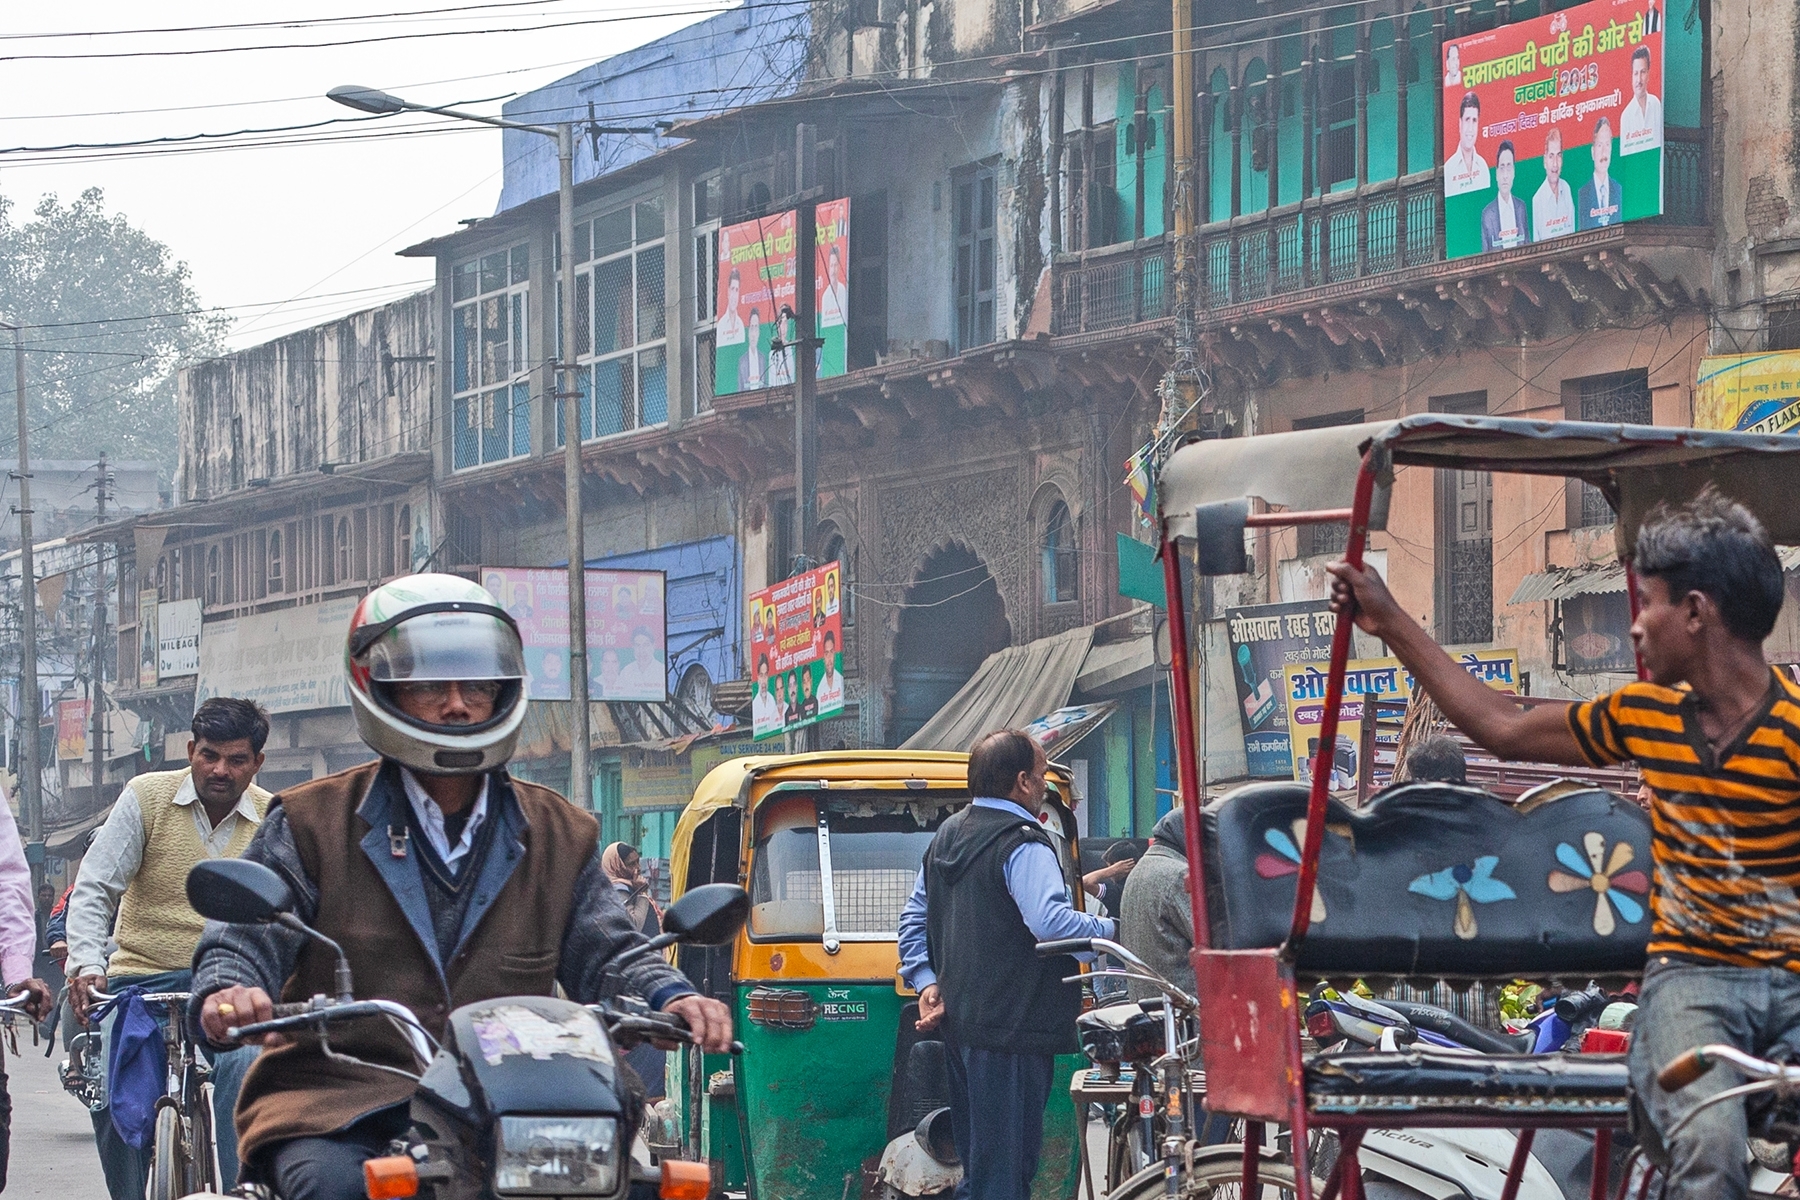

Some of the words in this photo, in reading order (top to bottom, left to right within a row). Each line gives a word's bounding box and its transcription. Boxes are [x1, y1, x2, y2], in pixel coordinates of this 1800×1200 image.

[1462, 41, 1537, 88] समाजवादी
[1540, 32, 1569, 67] पार्टी
[1573, 26, 1594, 59] की
[1597, 21, 1625, 53] ओर
[1628, 11, 1644, 46] से
[1514, 73, 1558, 105] नववर्ष
[1559, 62, 1599, 98] 2013
[1482, 125, 1489, 138] व
[1538, 106, 1550, 124] की
[1551, 101, 1574, 124] हार्दिक
[1230, 612, 1283, 643] ओसवाल
[1285, 612, 1310, 644] रबड़
[719, 744, 737, 755] DAILY
[738, 743, 764, 754] SERVICE
[764, 743, 773, 754] 24
[1372, 1128, 1434, 1149] Activa
